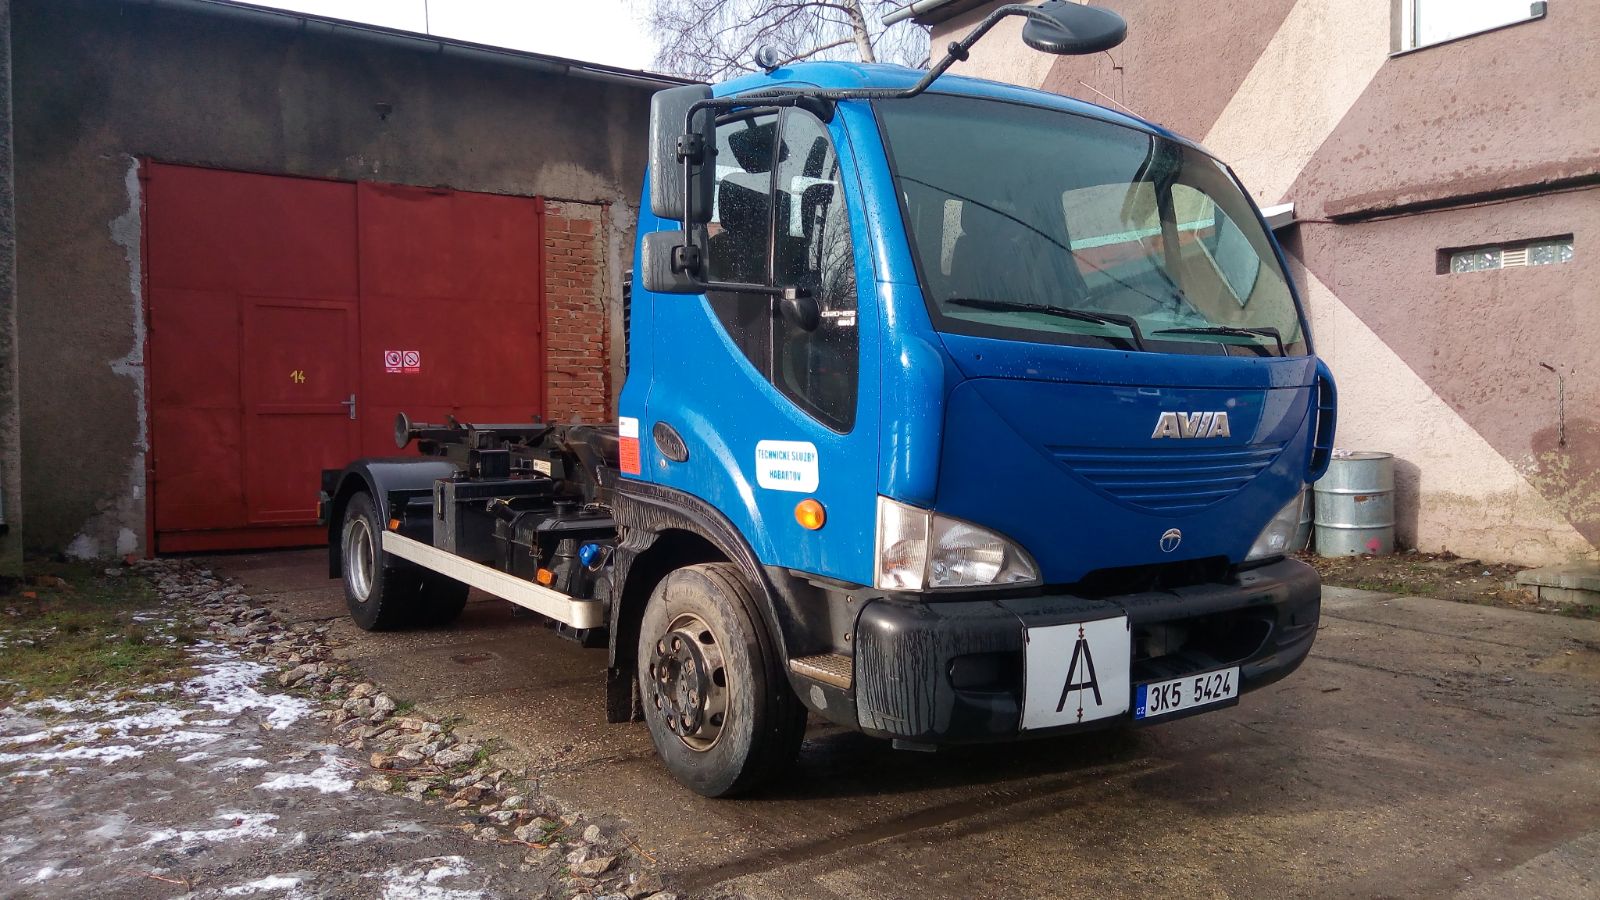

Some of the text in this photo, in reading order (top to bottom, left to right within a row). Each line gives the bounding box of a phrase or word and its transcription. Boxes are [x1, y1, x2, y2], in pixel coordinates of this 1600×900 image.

[290, 370, 306, 384] 14
[1151, 411, 1232, 439] AVIA
[1056, 638, 1103, 713] A
[1150, 671, 1231, 712] 3K5 5424
[1136, 706, 1146, 716] CZ
